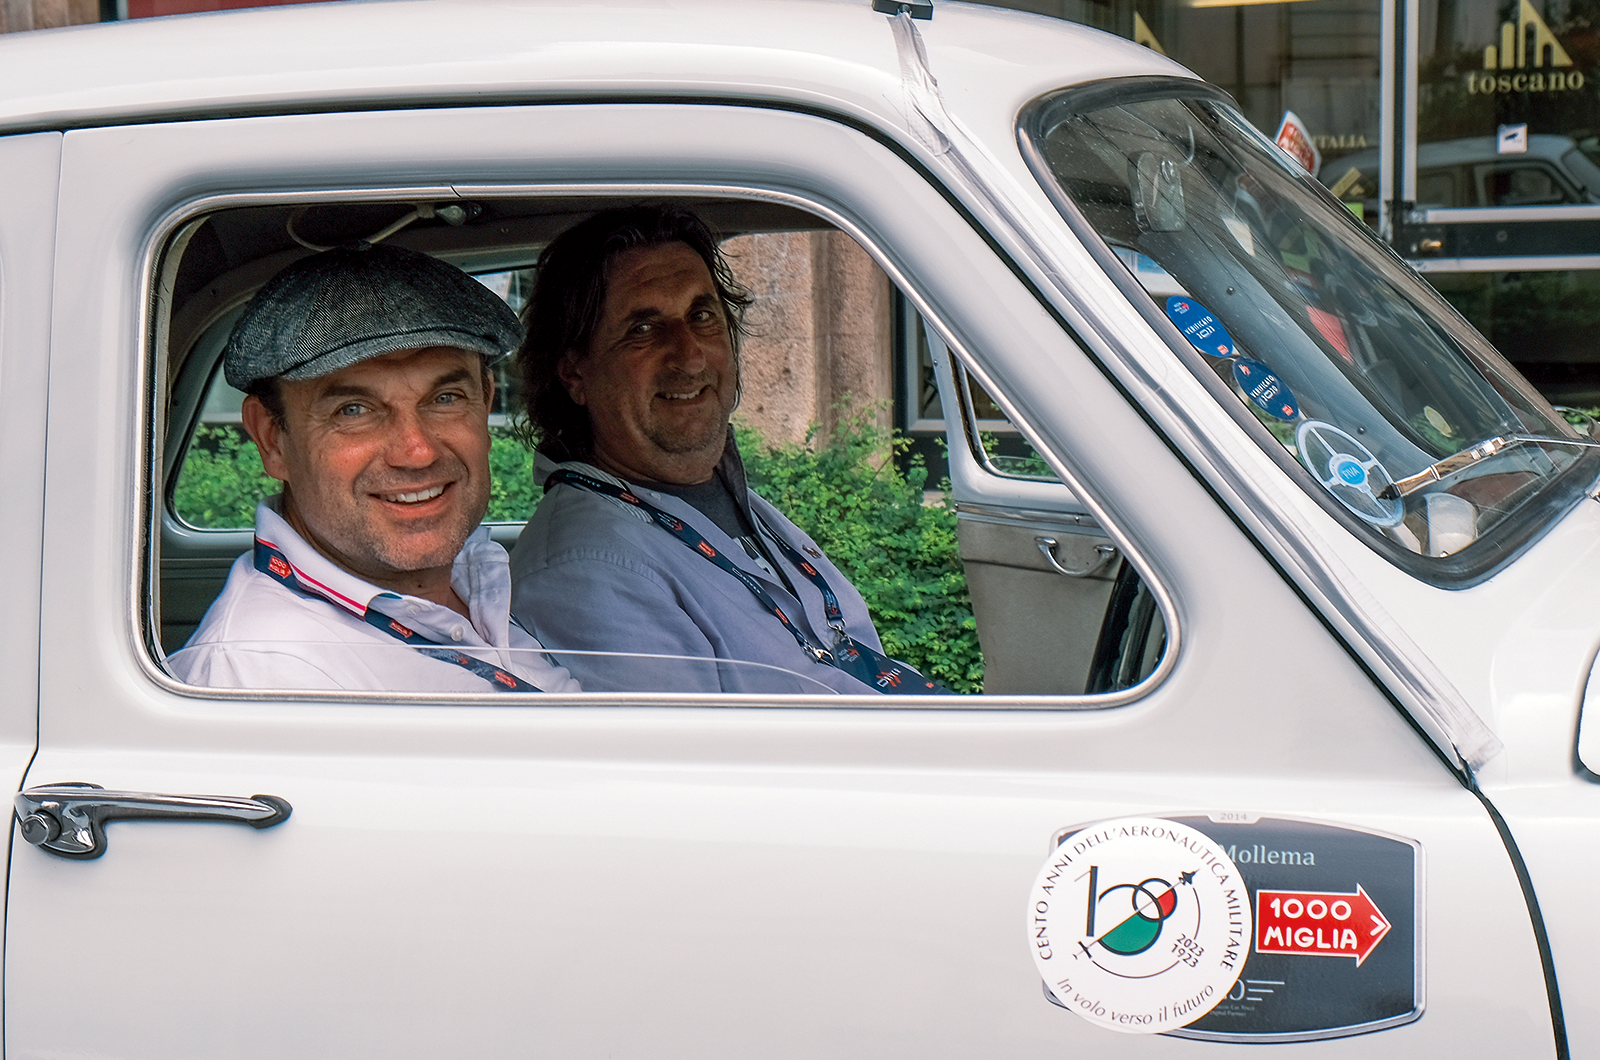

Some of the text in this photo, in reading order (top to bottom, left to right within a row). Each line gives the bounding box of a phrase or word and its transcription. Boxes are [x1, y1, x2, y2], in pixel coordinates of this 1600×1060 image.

[1467, 70, 1585, 95] toscano
[1185, 315, 1213, 335] VERIFICATO
[1250, 375, 1275, 398] VERIFICATO
[1342, 466, 1360, 480] FIVA
[1220, 812, 1247, 821] 2014
[1218, 844, 1316, 866] Mollema
[1035, 824, 1243, 972] CENTO ANNI DELL'AERONAUTICA MILITARE
[1270, 897, 1352, 921] 1000
[1176, 933, 1205, 957] 2023
[1263, 925, 1358, 950] MIGLIA
[1170, 943, 1199, 968] 1923
[1056, 977, 1073, 994] In
[1074, 992, 1107, 1018] volo
[1111, 1009, 1153, 1026] verso
[1158, 1006, 1168, 1023] il
[1172, 984, 1214, 1019] futuro
